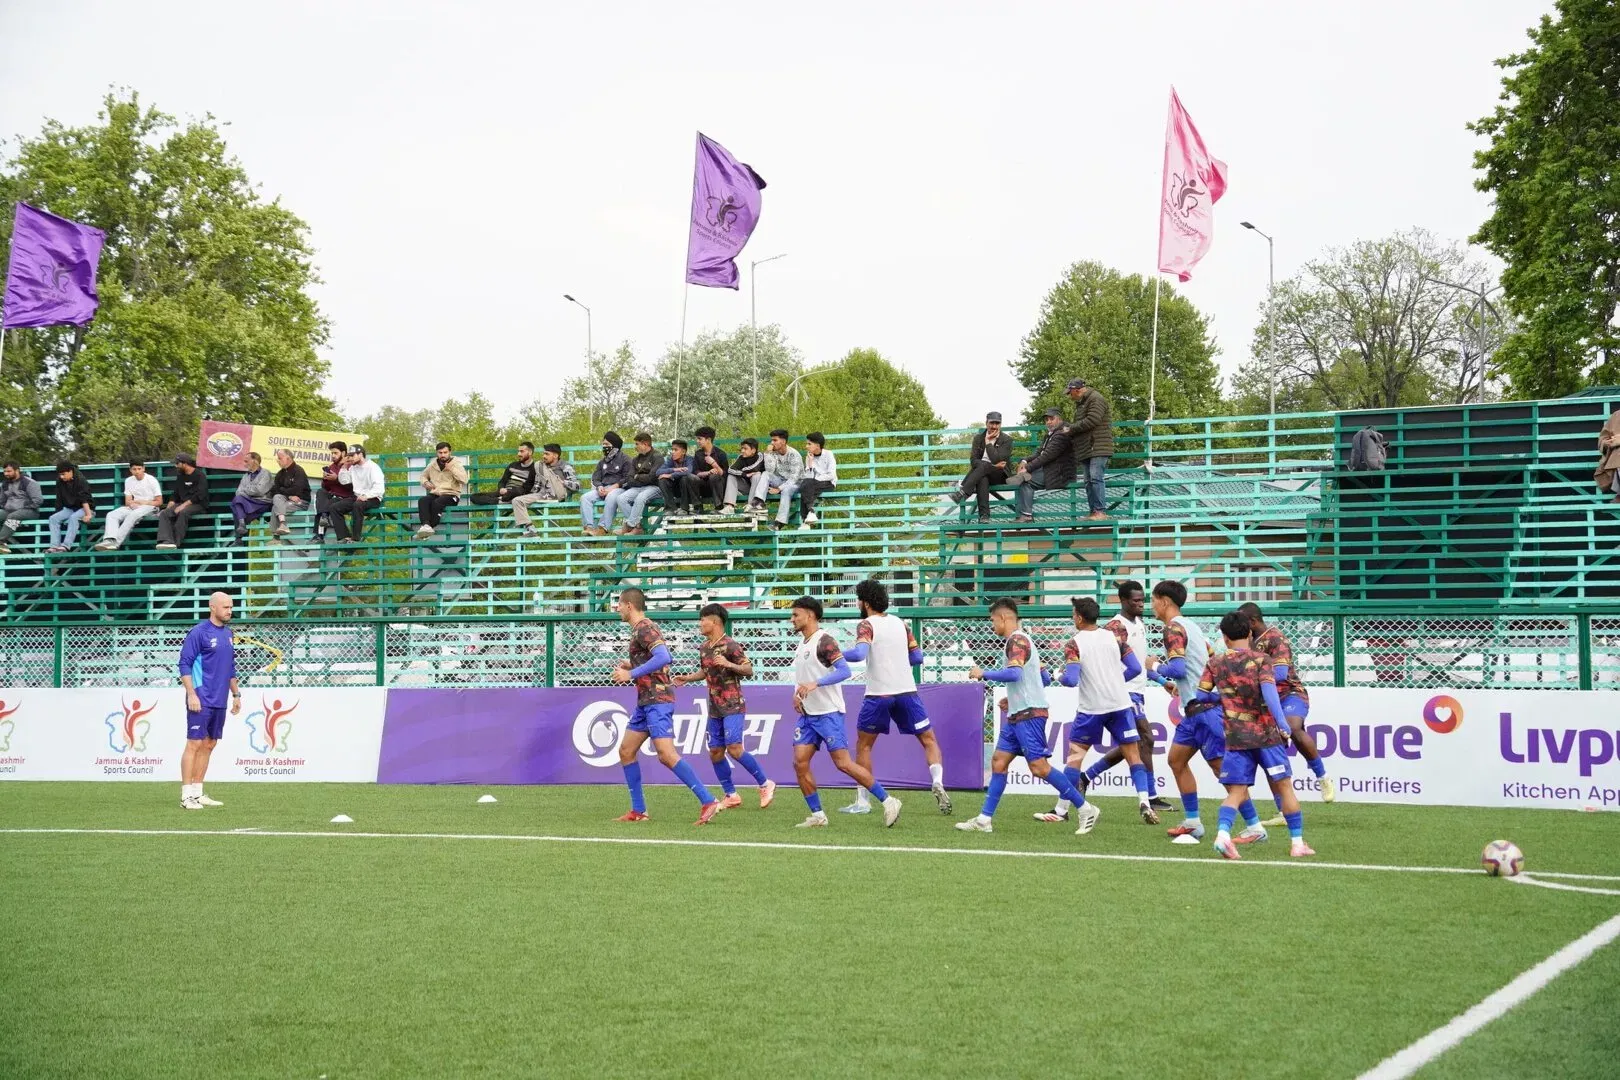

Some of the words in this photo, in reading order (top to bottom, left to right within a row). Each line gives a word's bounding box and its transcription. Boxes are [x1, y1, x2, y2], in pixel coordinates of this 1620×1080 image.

[268, 436, 295, 446] SOUTH
[296, 439, 324, 449] STAND
[1500, 712, 1620, 777] Livp
[0, 757, 25, 765] ashmir
[95, 757, 122, 765] Jammu
[124, 757, 130, 765] &
[131, 757, 163, 765] Kashmir
[235, 758, 263, 766] Jammu
[265, 758, 271, 766] &
[273, 757, 305, 765] Kashmir
[103, 766, 126, 774] Sports
[128, 766, 153, 774] Council
[244, 767, 267, 776] Sports
[269, 767, 296, 775] Council
[1293, 776, 1333, 791] ate
[1339, 776, 1422, 794] Purifiers
[1503, 782, 1580, 800] Kitchen
[1588, 785, 1620, 806] Ap
